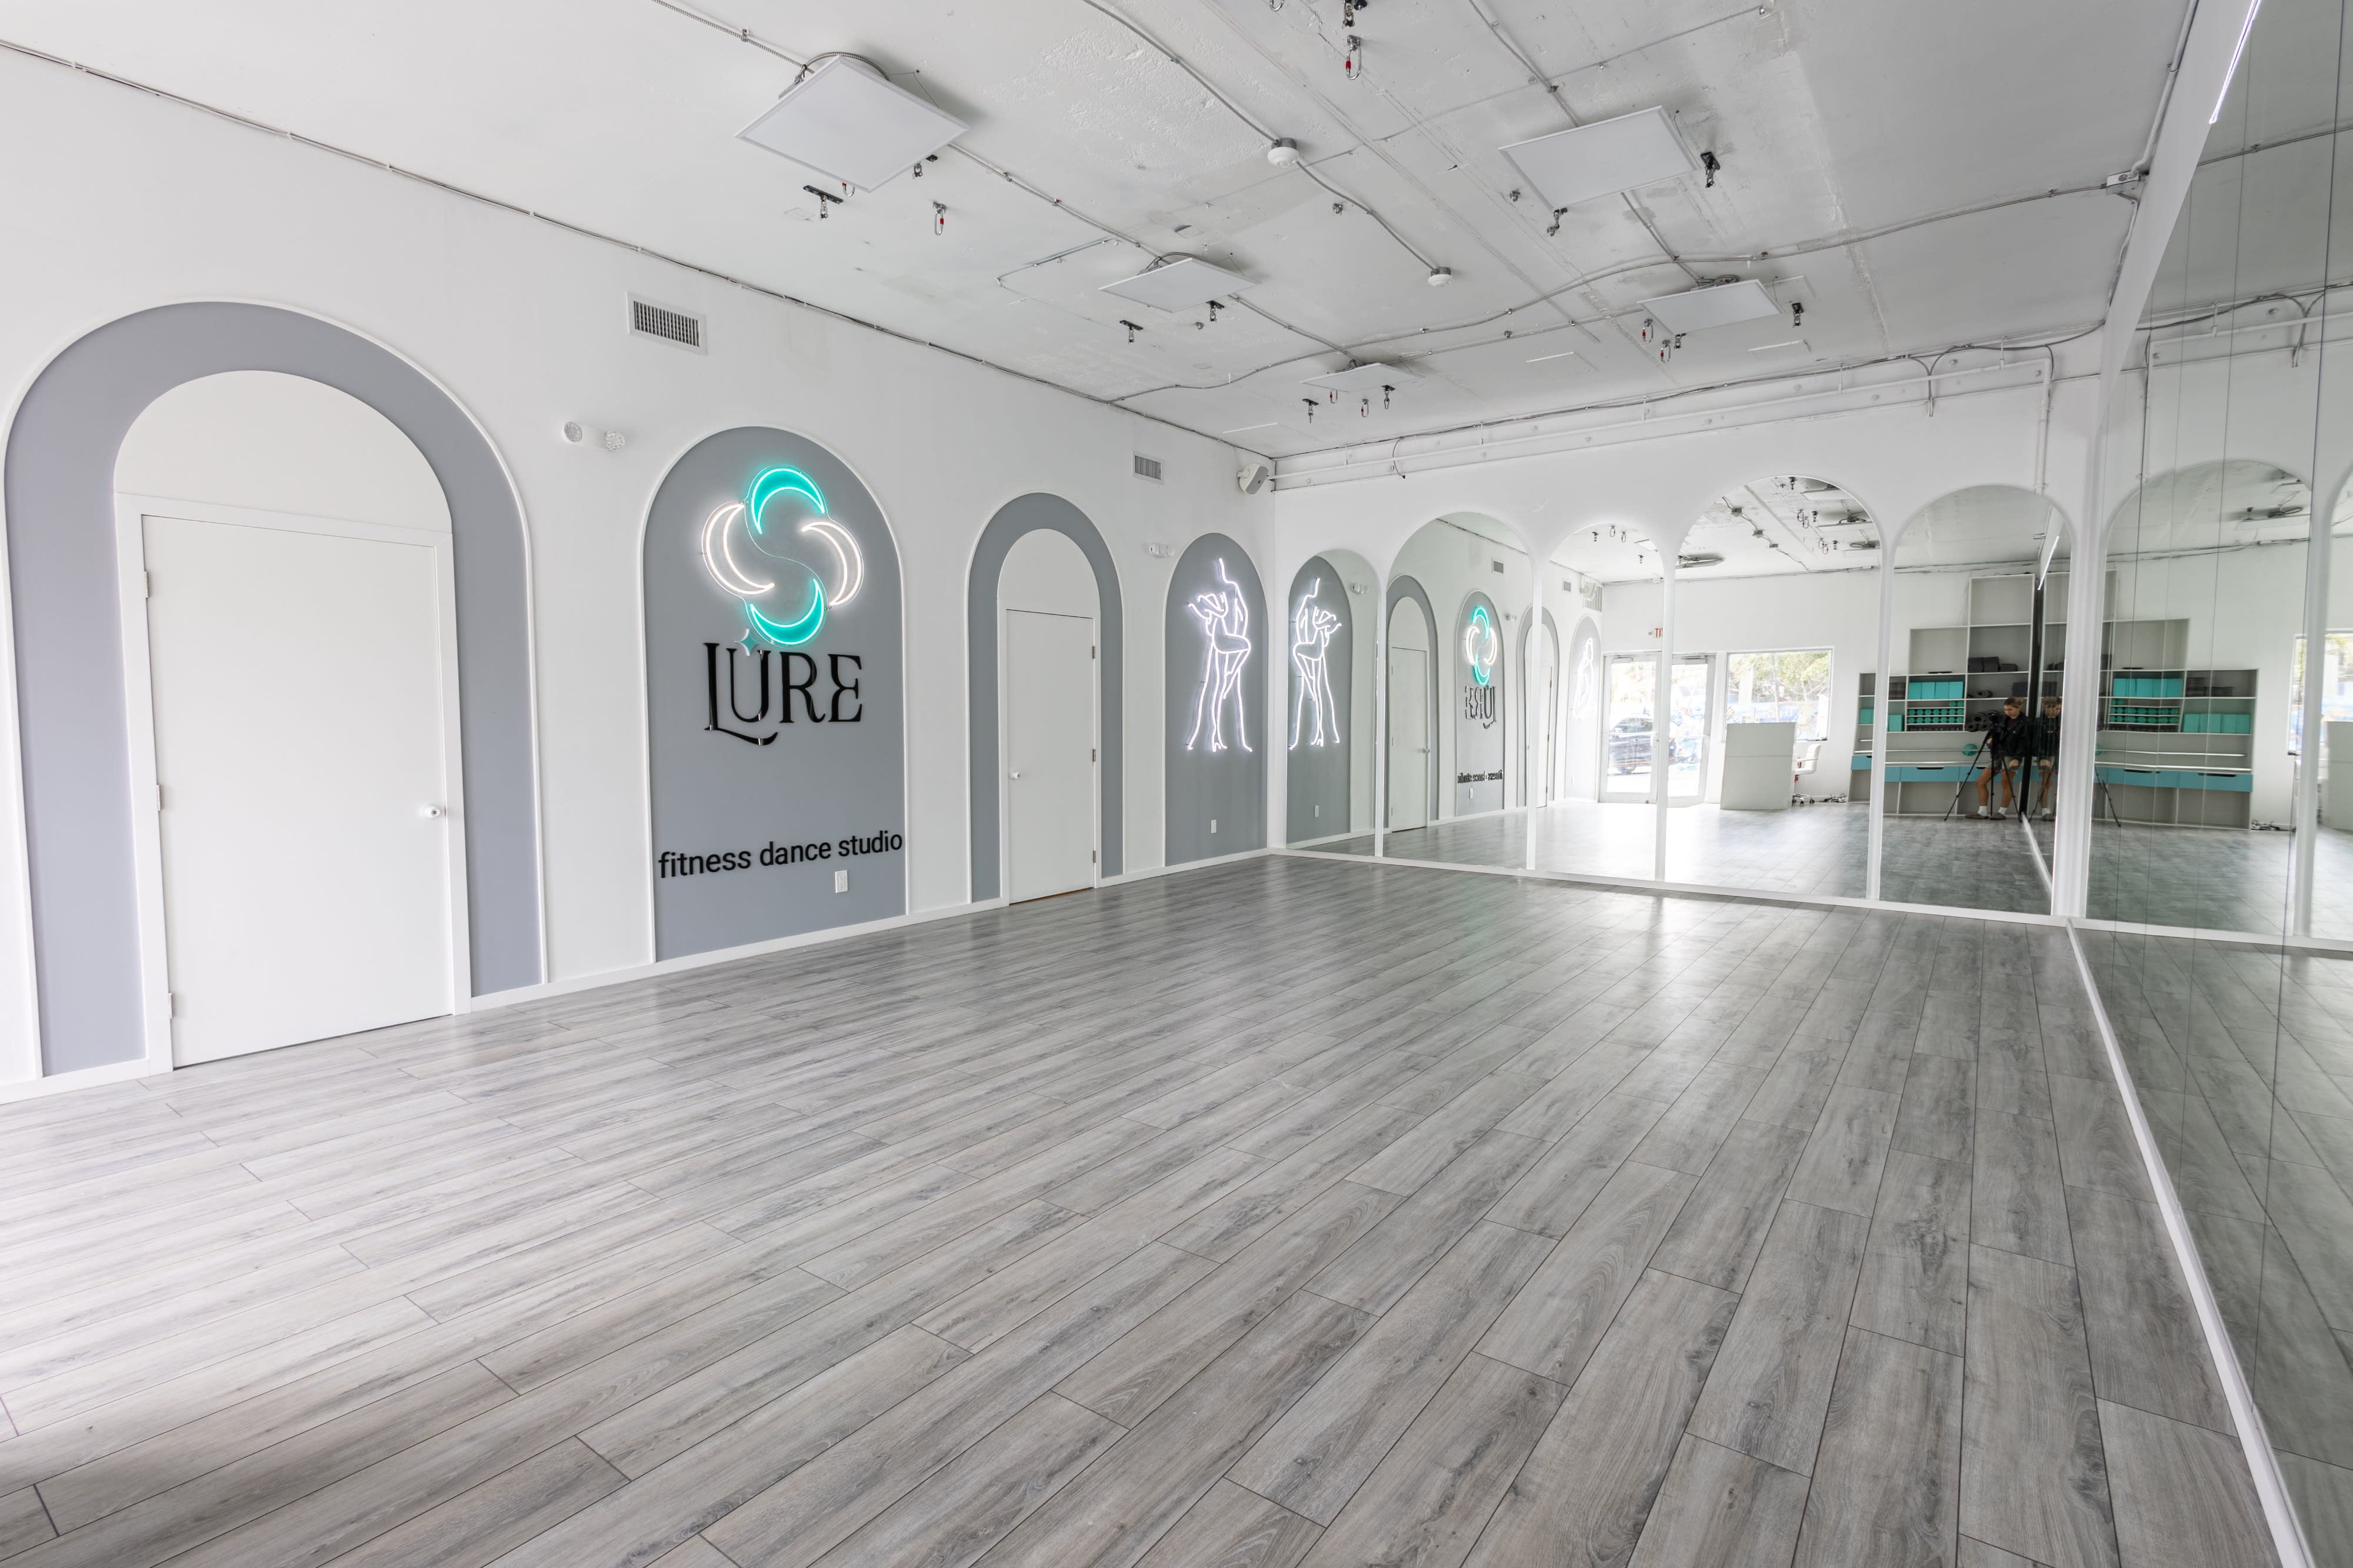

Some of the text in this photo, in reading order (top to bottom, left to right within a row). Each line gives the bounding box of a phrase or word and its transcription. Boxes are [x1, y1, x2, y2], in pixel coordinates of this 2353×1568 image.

[703, 642, 862, 746] LURE
[658, 830, 903, 879] fitness dance studio
